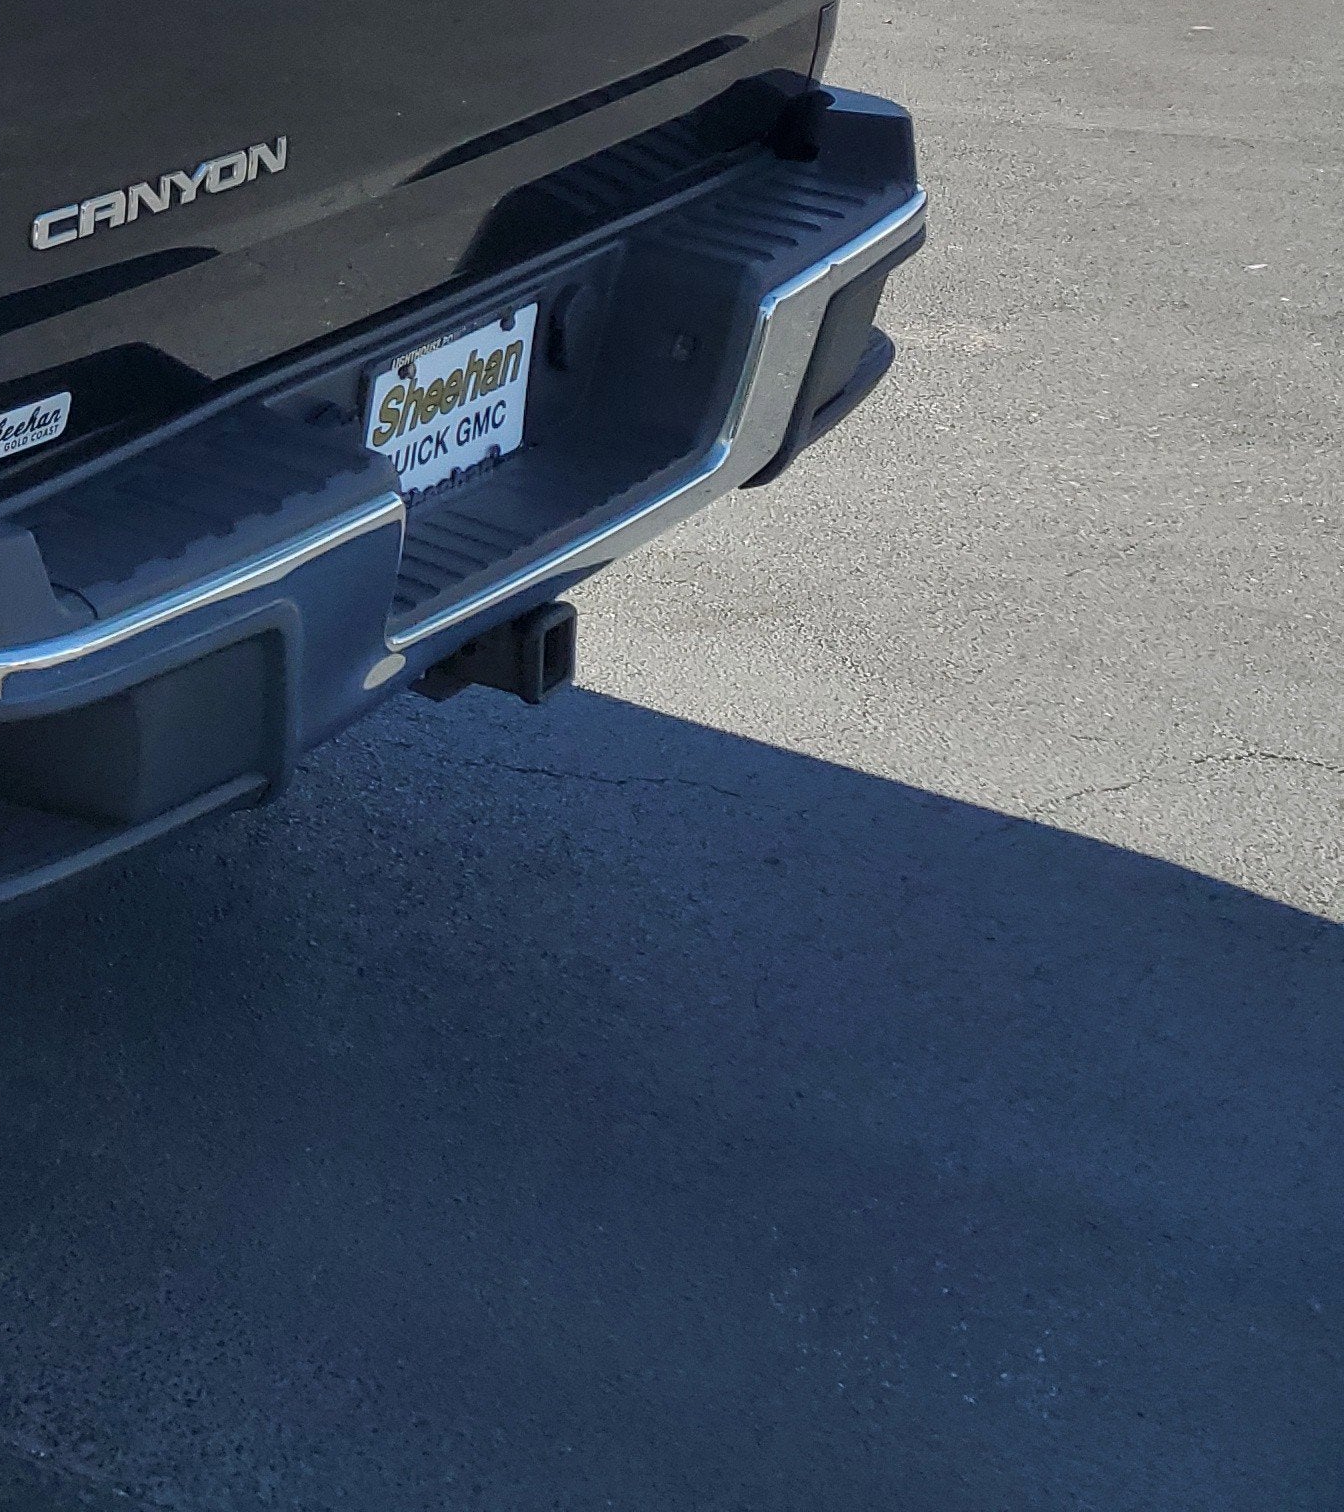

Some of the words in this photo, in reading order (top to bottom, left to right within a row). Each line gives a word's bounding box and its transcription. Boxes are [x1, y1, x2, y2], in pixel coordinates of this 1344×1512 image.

[31, 135, 288, 251] CANYON
[5, 437, 28, 452] GOLD
[32, 425, 59, 442] COAST
[372, 339, 525, 448] Sheehan
[389, 425, 451, 477] UICK
[455, 398, 508, 447] GMC
